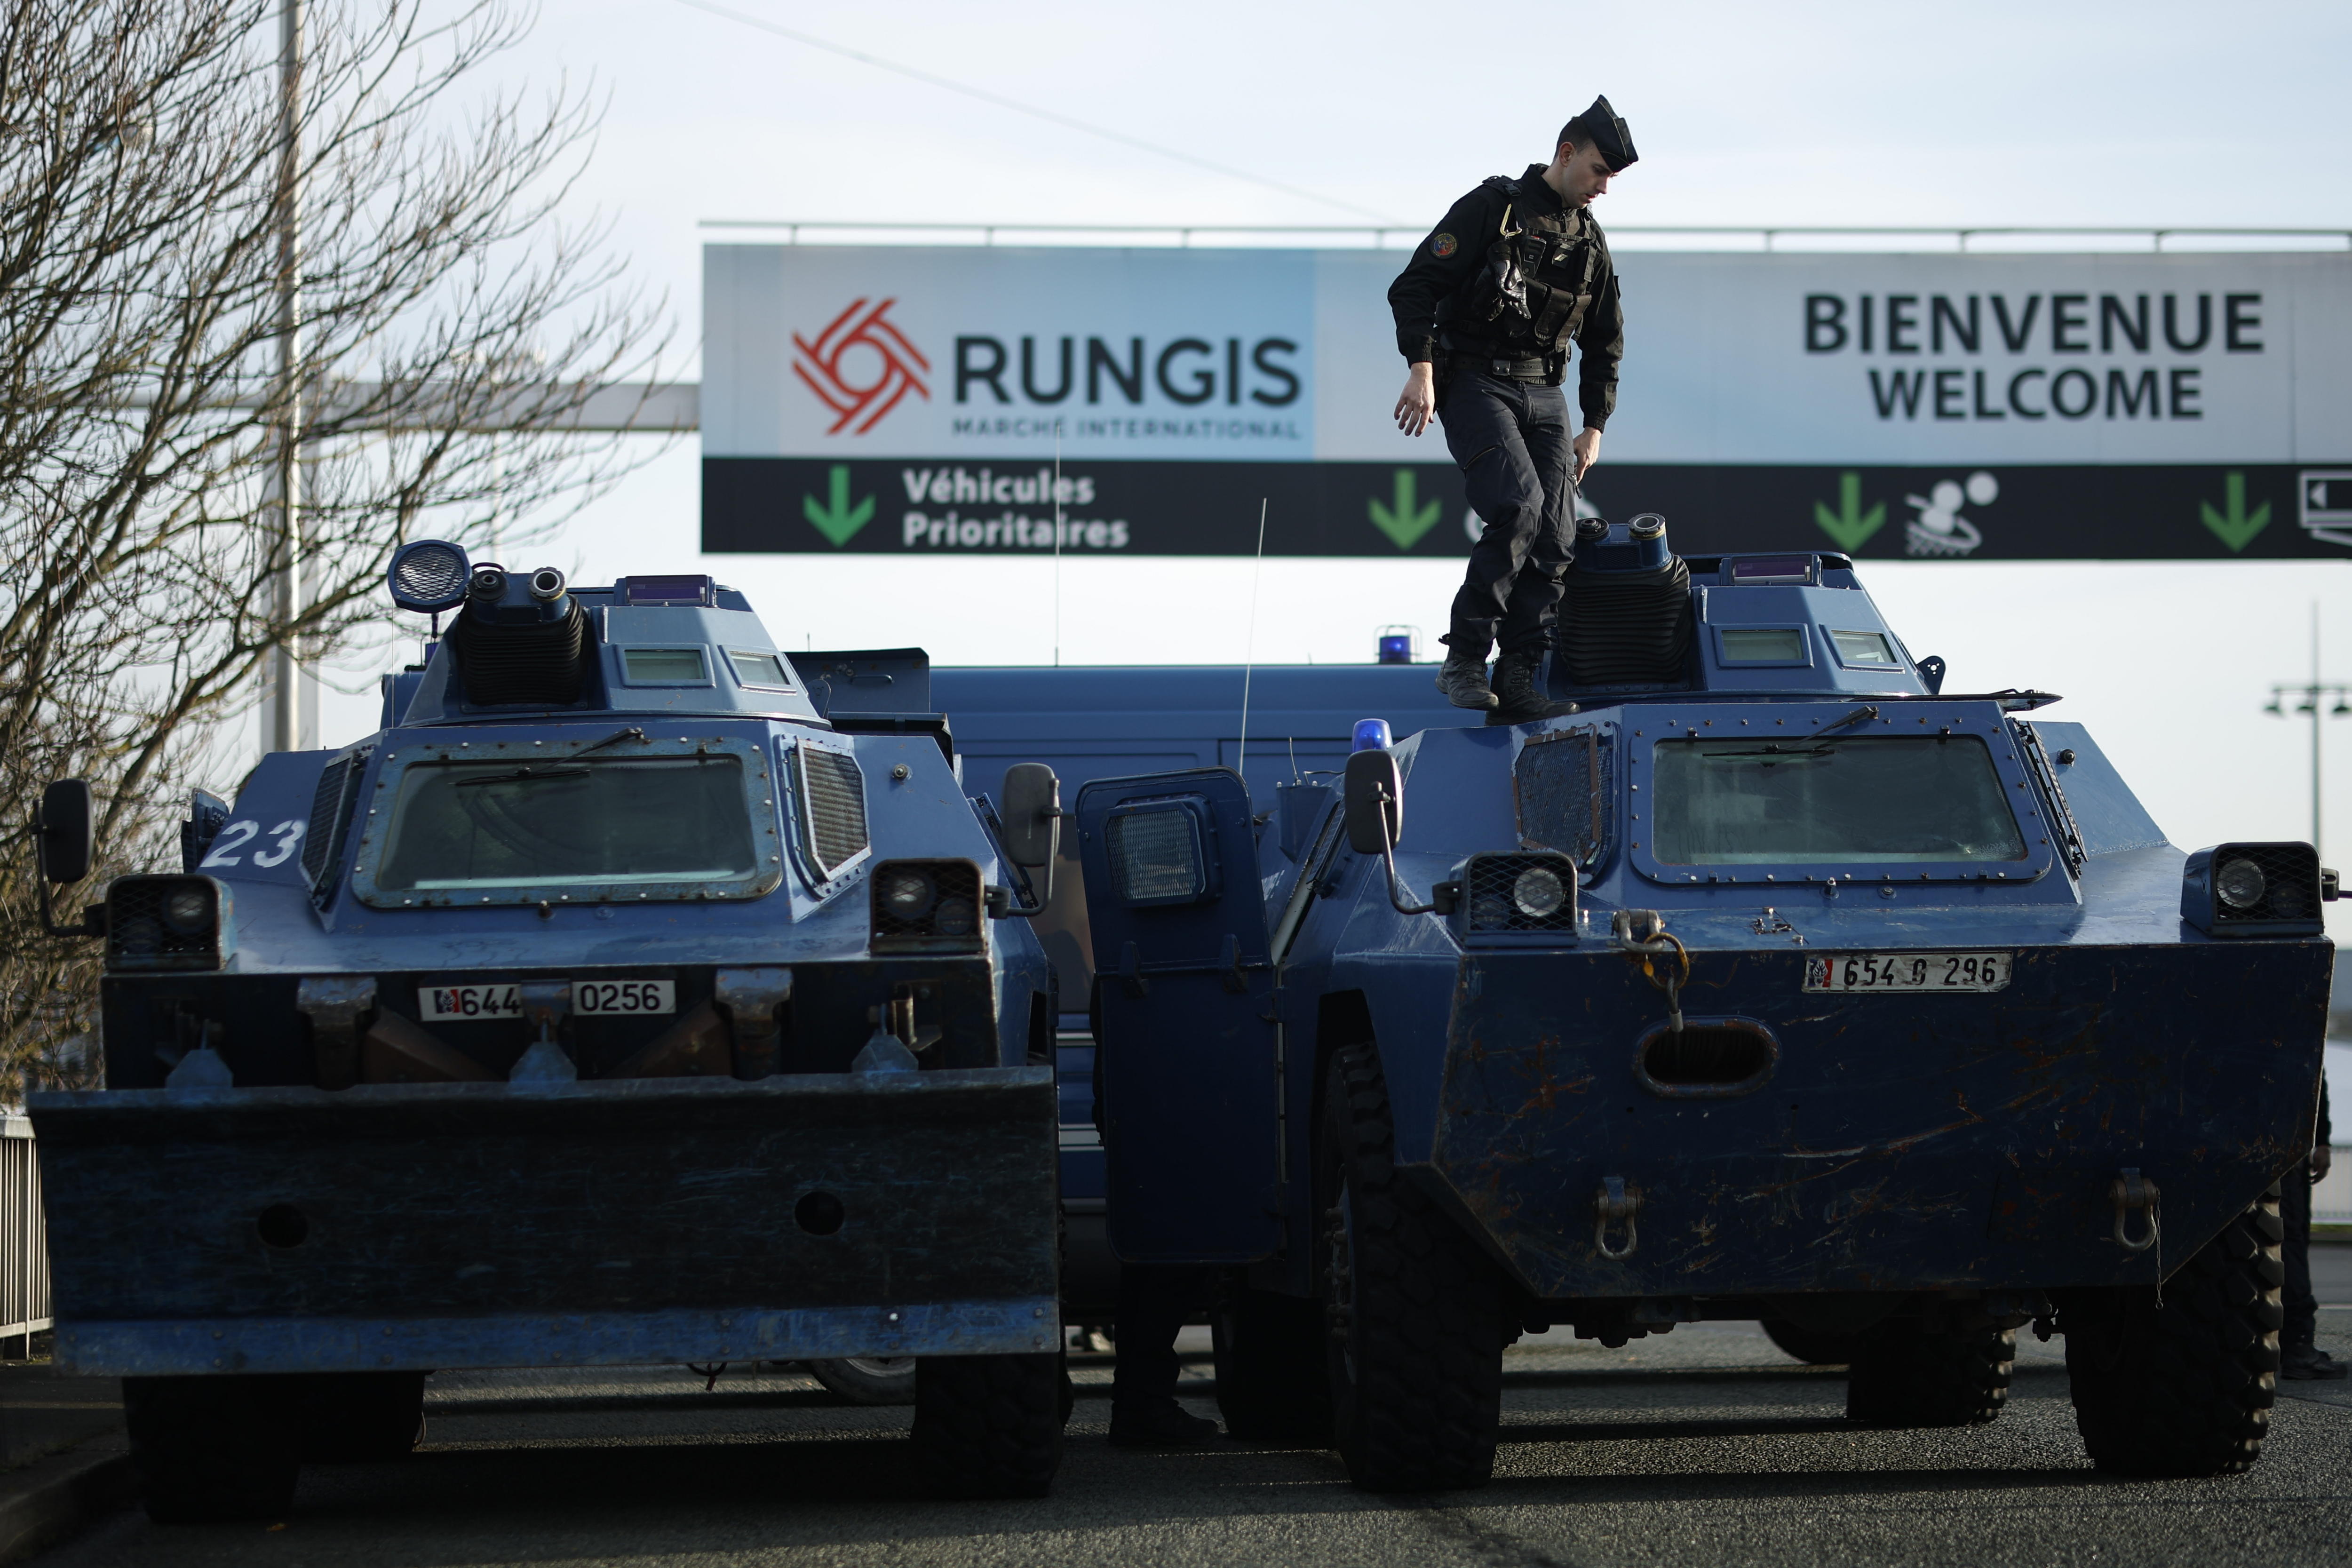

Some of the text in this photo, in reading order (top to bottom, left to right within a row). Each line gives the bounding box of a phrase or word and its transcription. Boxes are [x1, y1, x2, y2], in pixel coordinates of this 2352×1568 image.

[1805, 293, 2264, 354] BIENVENUE
[954, 336, 1301, 406] RUNGIS
[1869, 369, 2203, 420] WELCOME
[1078, 418, 1300, 439] INTERNATIONAL
[903, 469, 1094, 504] Véhicules
[904, 512, 1128, 548] Prioritaires
[200, 820, 305, 868] 23
[1844, 959, 1894, 986] 654
[1944, 958, 1996, 985] 296
[461, 984, 660, 1016] 644 0256
